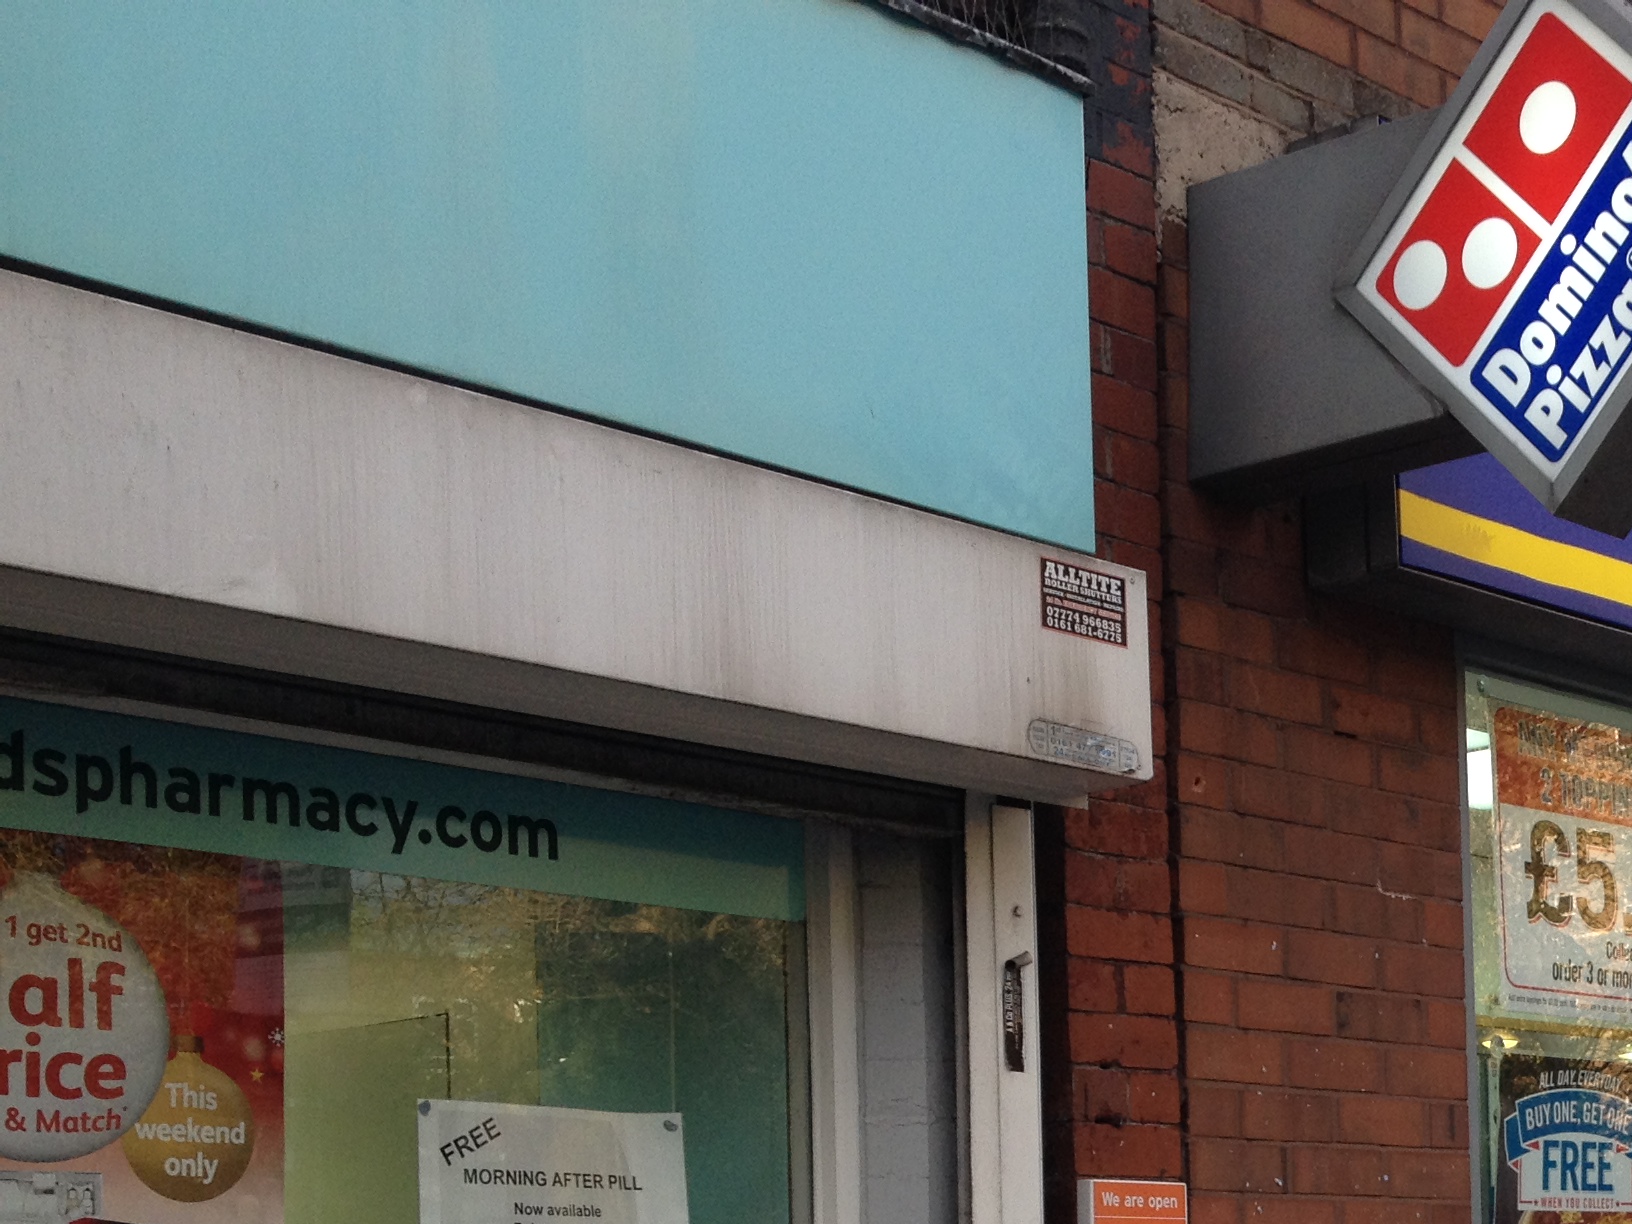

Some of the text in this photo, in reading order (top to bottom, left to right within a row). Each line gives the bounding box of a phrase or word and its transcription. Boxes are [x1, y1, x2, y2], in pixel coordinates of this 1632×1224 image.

[1044, 561, 1122, 596] ALLTITE
[1044, 578, 1123, 604] ROLLER SHUTTERS
[1046, 606, 1080, 623] 07774
[1082, 611, 1122, 633] 966835
[1047, 617, 1072, 632] 0161
[0, 730, 559, 861] dspharmacy.com
[4, 915, 123, 953] 1 get 2nd
[1552, 958, 1583, 982] order
[1586, 961, 1594, 984] 3
[1597, 967, 1610, 986] or
[8, 957, 126, 1031] alf
[1539, 1070, 1555, 1089] ALL
[165, 1082, 218, 1111] This
[5, 1108, 25, 1132] &
[135, 1117, 247, 1146] weekend
[1525, 1101, 1632, 1135] BUY ONE, GET ONE
[440, 1117, 502, 1166] FREE
[164, 1153, 220, 1184] only
[463, 1168, 643, 1191] MORNING AFTER PILL
[1541, 1140, 1614, 1192] FREE
[514, 1202, 601, 1218] Now available
[1102, 1191, 1178, 1211] We are open
[1540, 1197, 1614, 1210] WHEN YOU COLLECT
